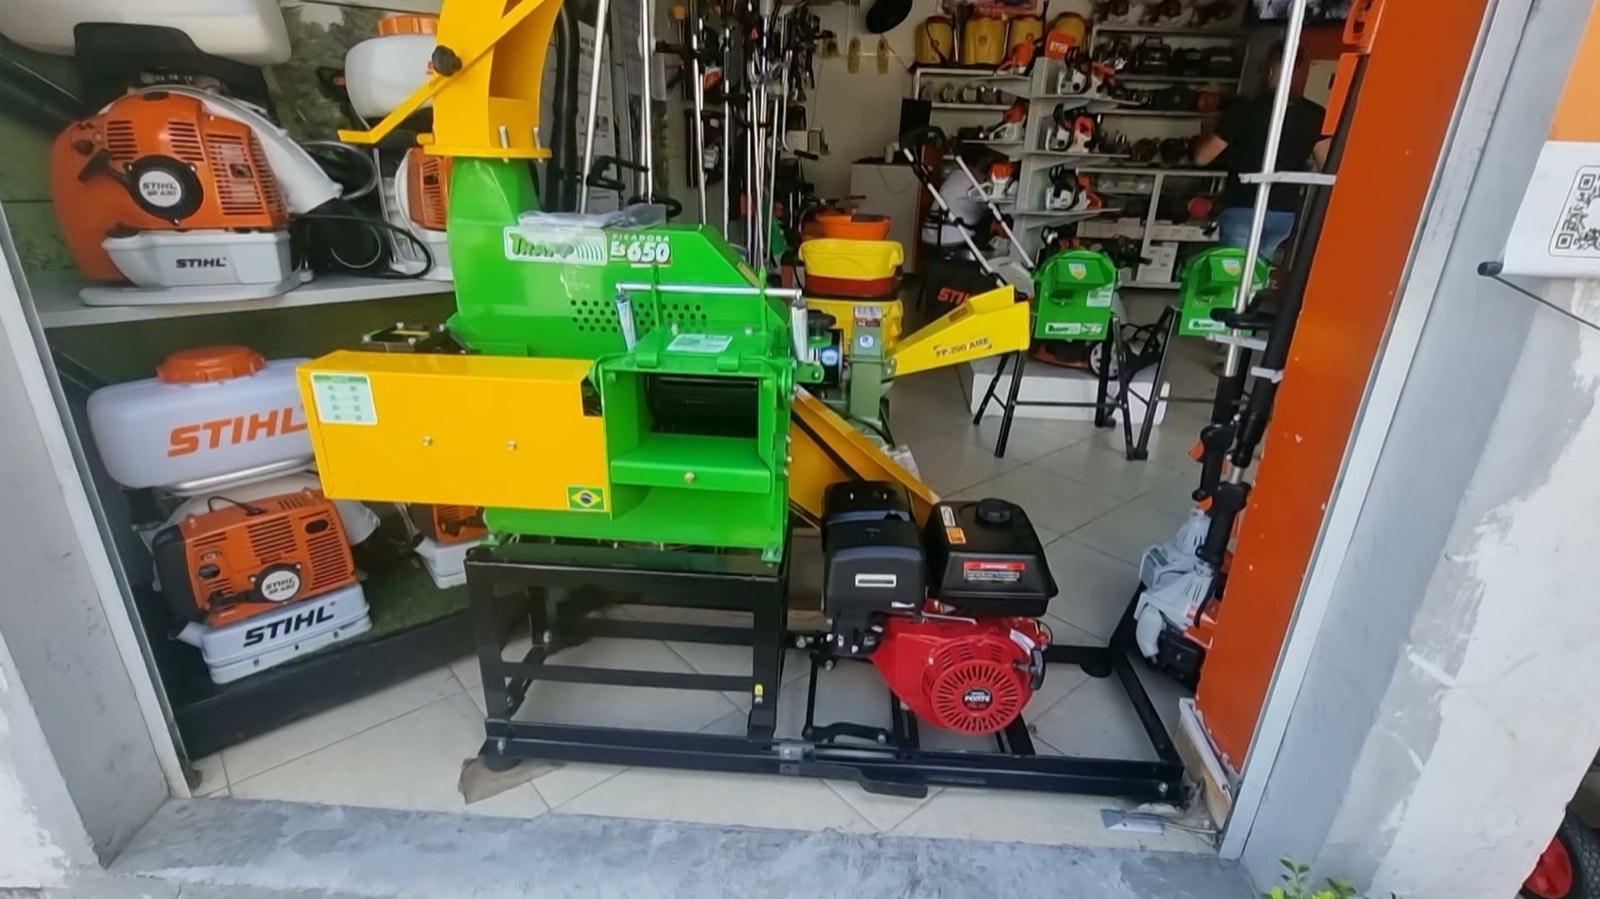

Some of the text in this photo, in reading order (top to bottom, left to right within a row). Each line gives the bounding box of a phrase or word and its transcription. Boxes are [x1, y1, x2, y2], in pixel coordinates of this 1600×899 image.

[142, 182, 177, 190] STIHL
[627, 240, 670, 263] 650
[176, 258, 227, 268] STIHL
[167, 406, 308, 458] STIHL
[264, 577, 295, 591] STIHL
[243, 605, 334, 647] STIHL
